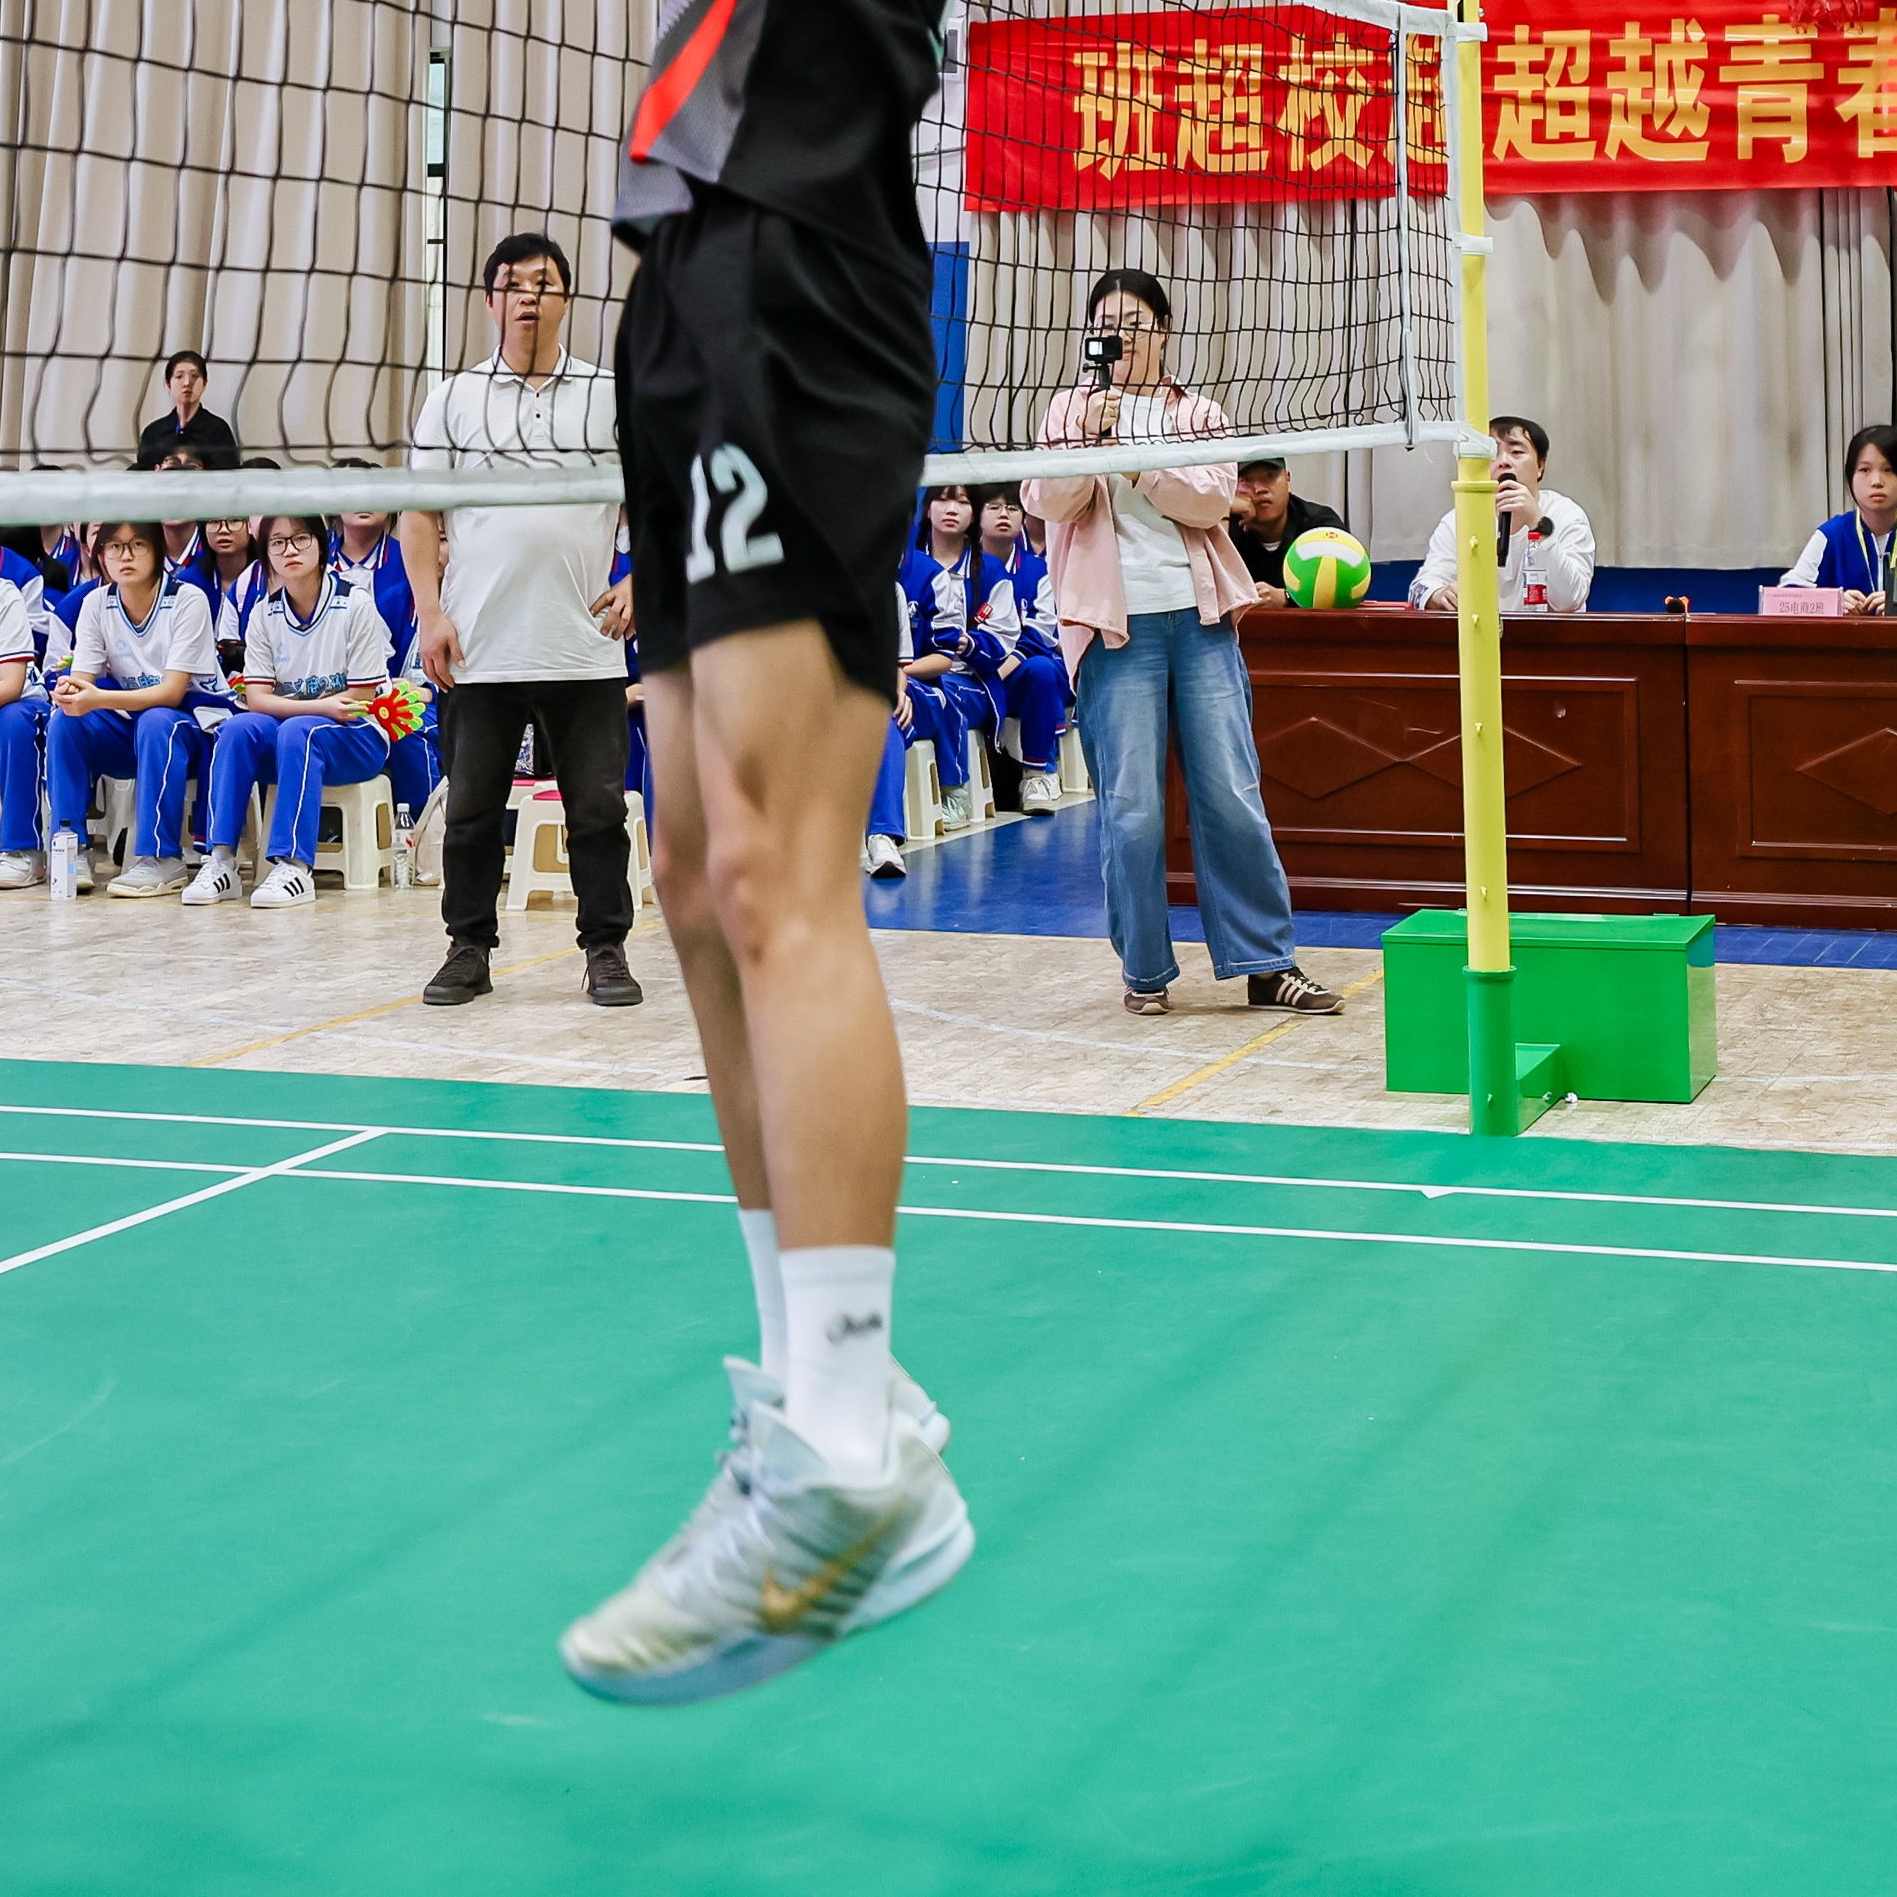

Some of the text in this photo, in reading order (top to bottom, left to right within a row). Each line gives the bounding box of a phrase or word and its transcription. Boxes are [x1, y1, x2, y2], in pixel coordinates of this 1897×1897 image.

[685, 442, 786, 585] 12
[1779, 601, 1825, 615] 25电商2班
